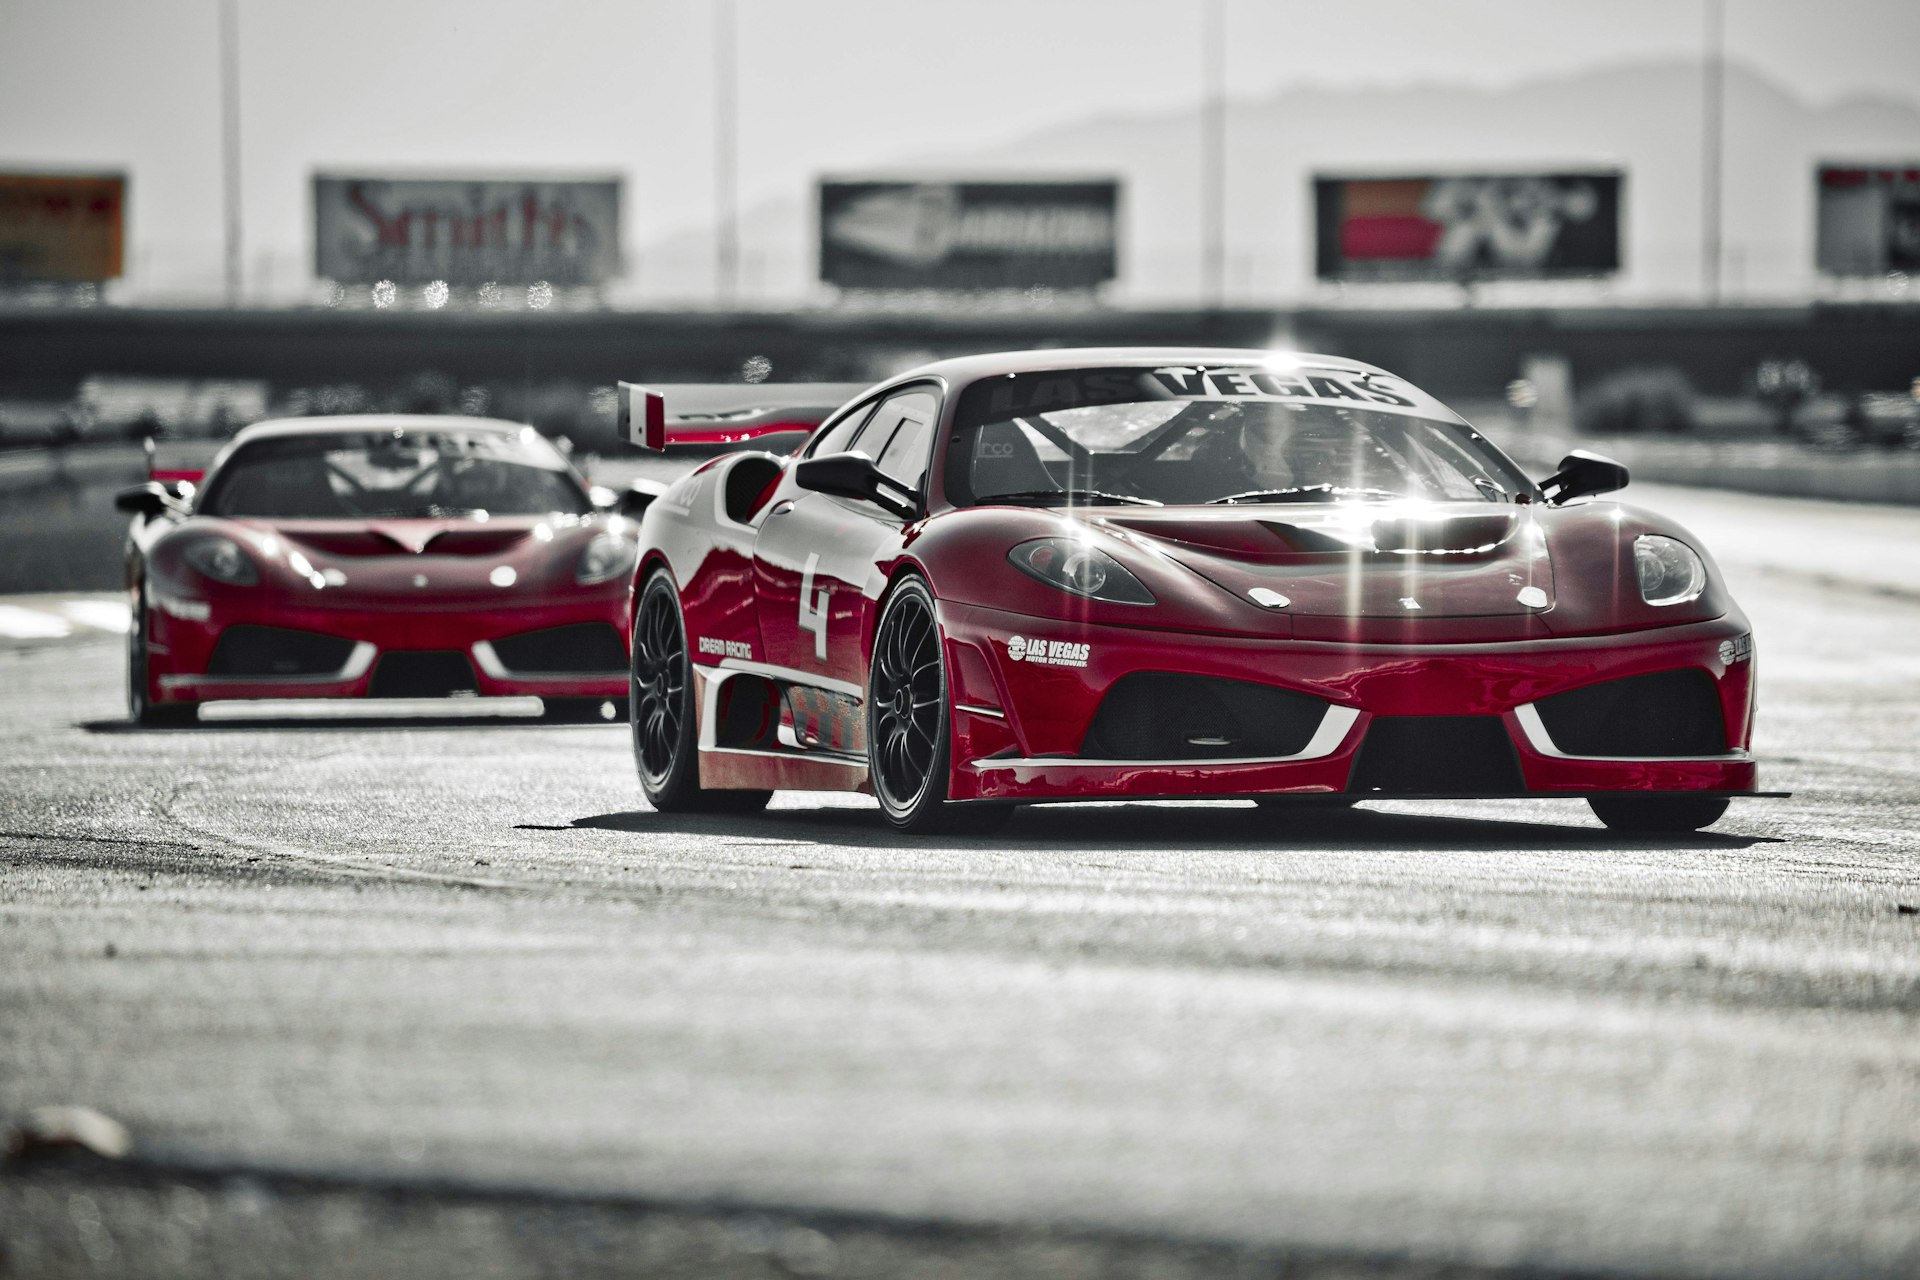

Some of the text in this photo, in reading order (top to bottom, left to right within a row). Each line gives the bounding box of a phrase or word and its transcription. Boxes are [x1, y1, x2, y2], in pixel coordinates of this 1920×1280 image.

[990, 370, 1417, 414] LAS VEGAS
[798, 551, 830, 661] 4
[698, 636, 752, 659] DREAM RACING
[1026, 638, 1091, 661] LAS VEGAS
[1025, 655, 1087, 668] MOTOR SPEEDWAY
